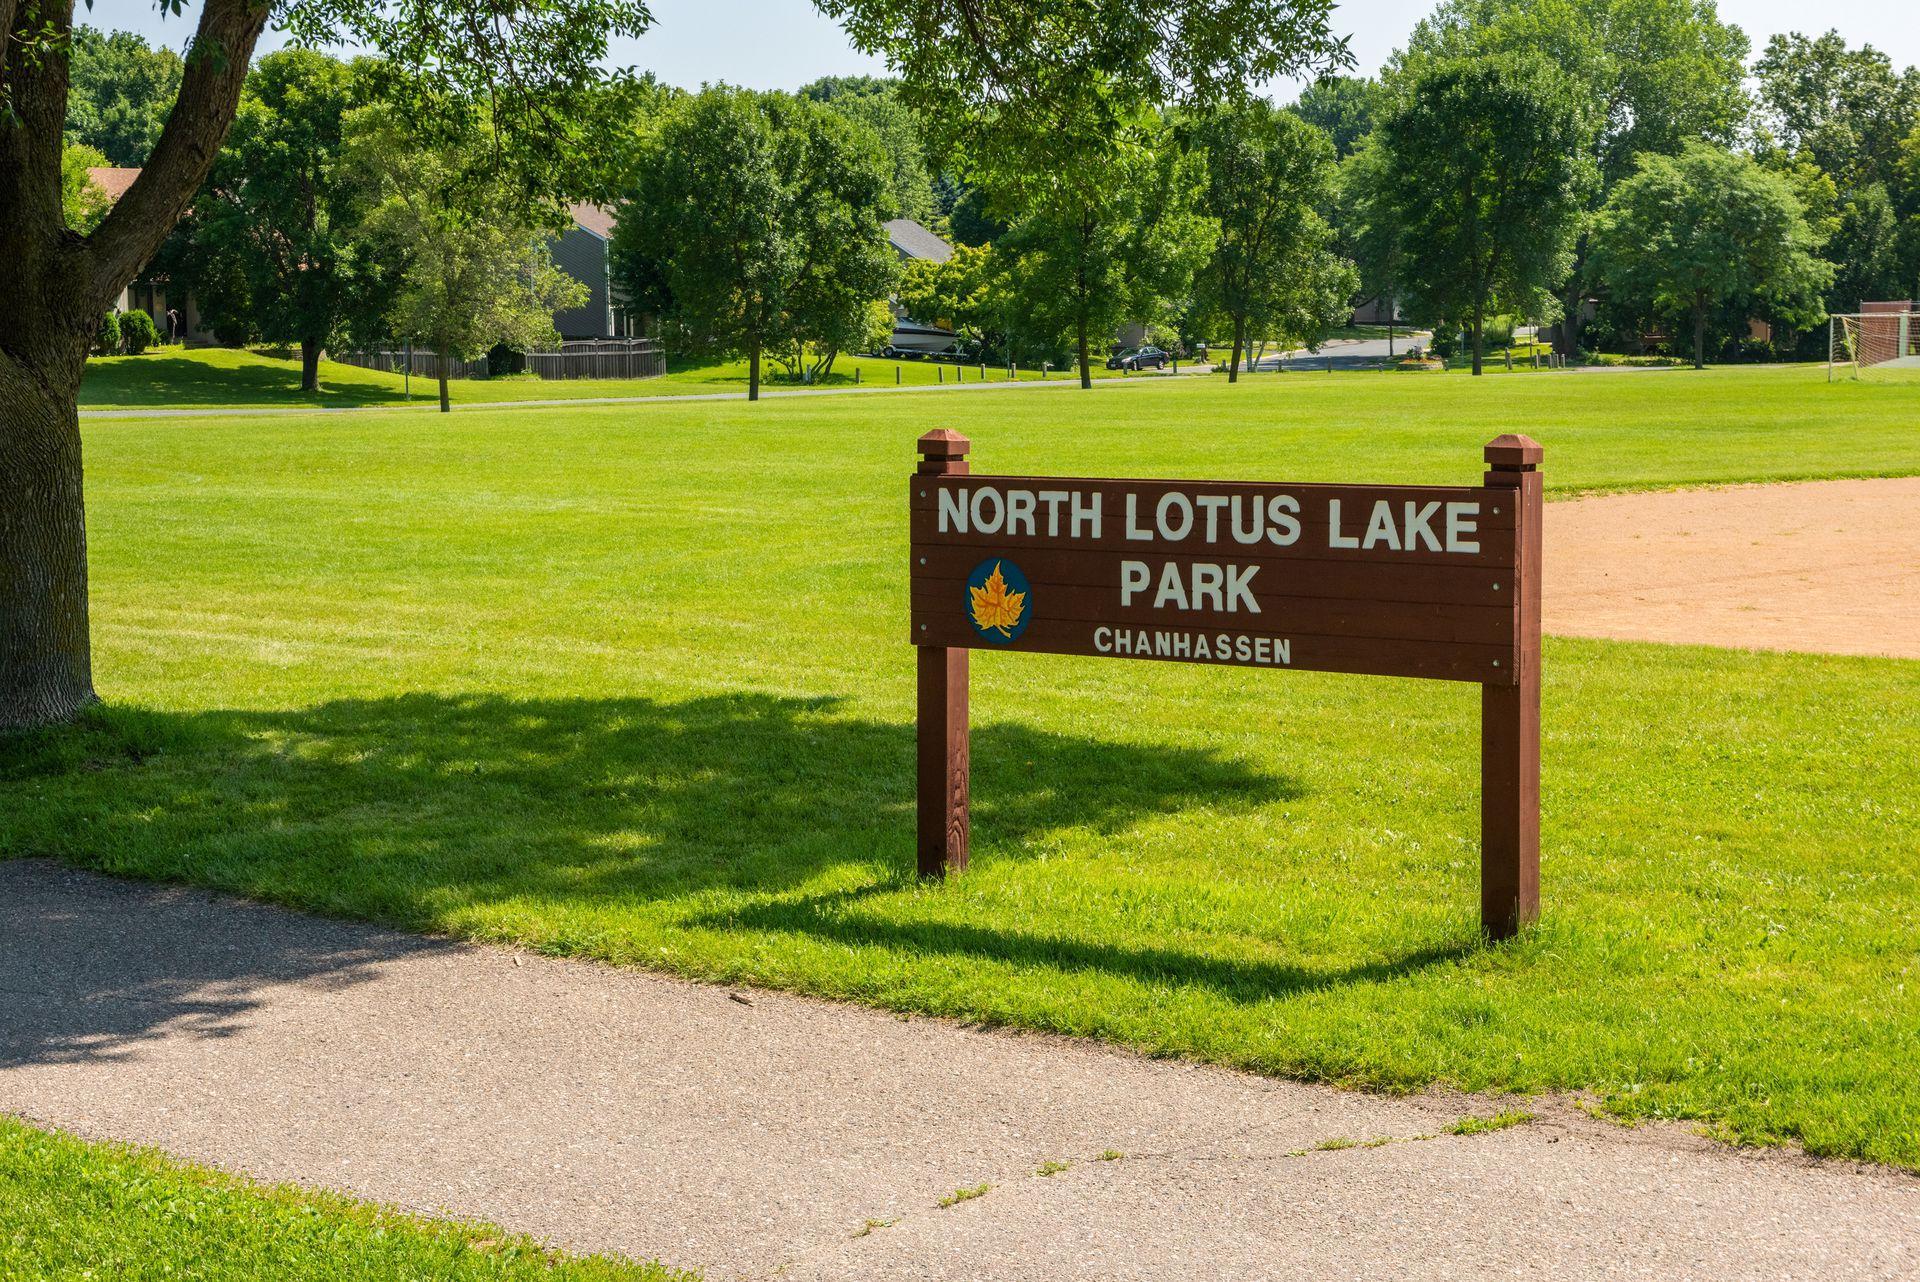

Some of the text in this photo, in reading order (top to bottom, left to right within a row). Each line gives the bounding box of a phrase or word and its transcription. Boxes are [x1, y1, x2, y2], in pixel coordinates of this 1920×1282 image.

[938, 486, 1481, 553] NORTH LOTUS LAKE
[1121, 560, 1263, 614] PARK
[1093, 626, 1292, 665] CHANHASSEN
